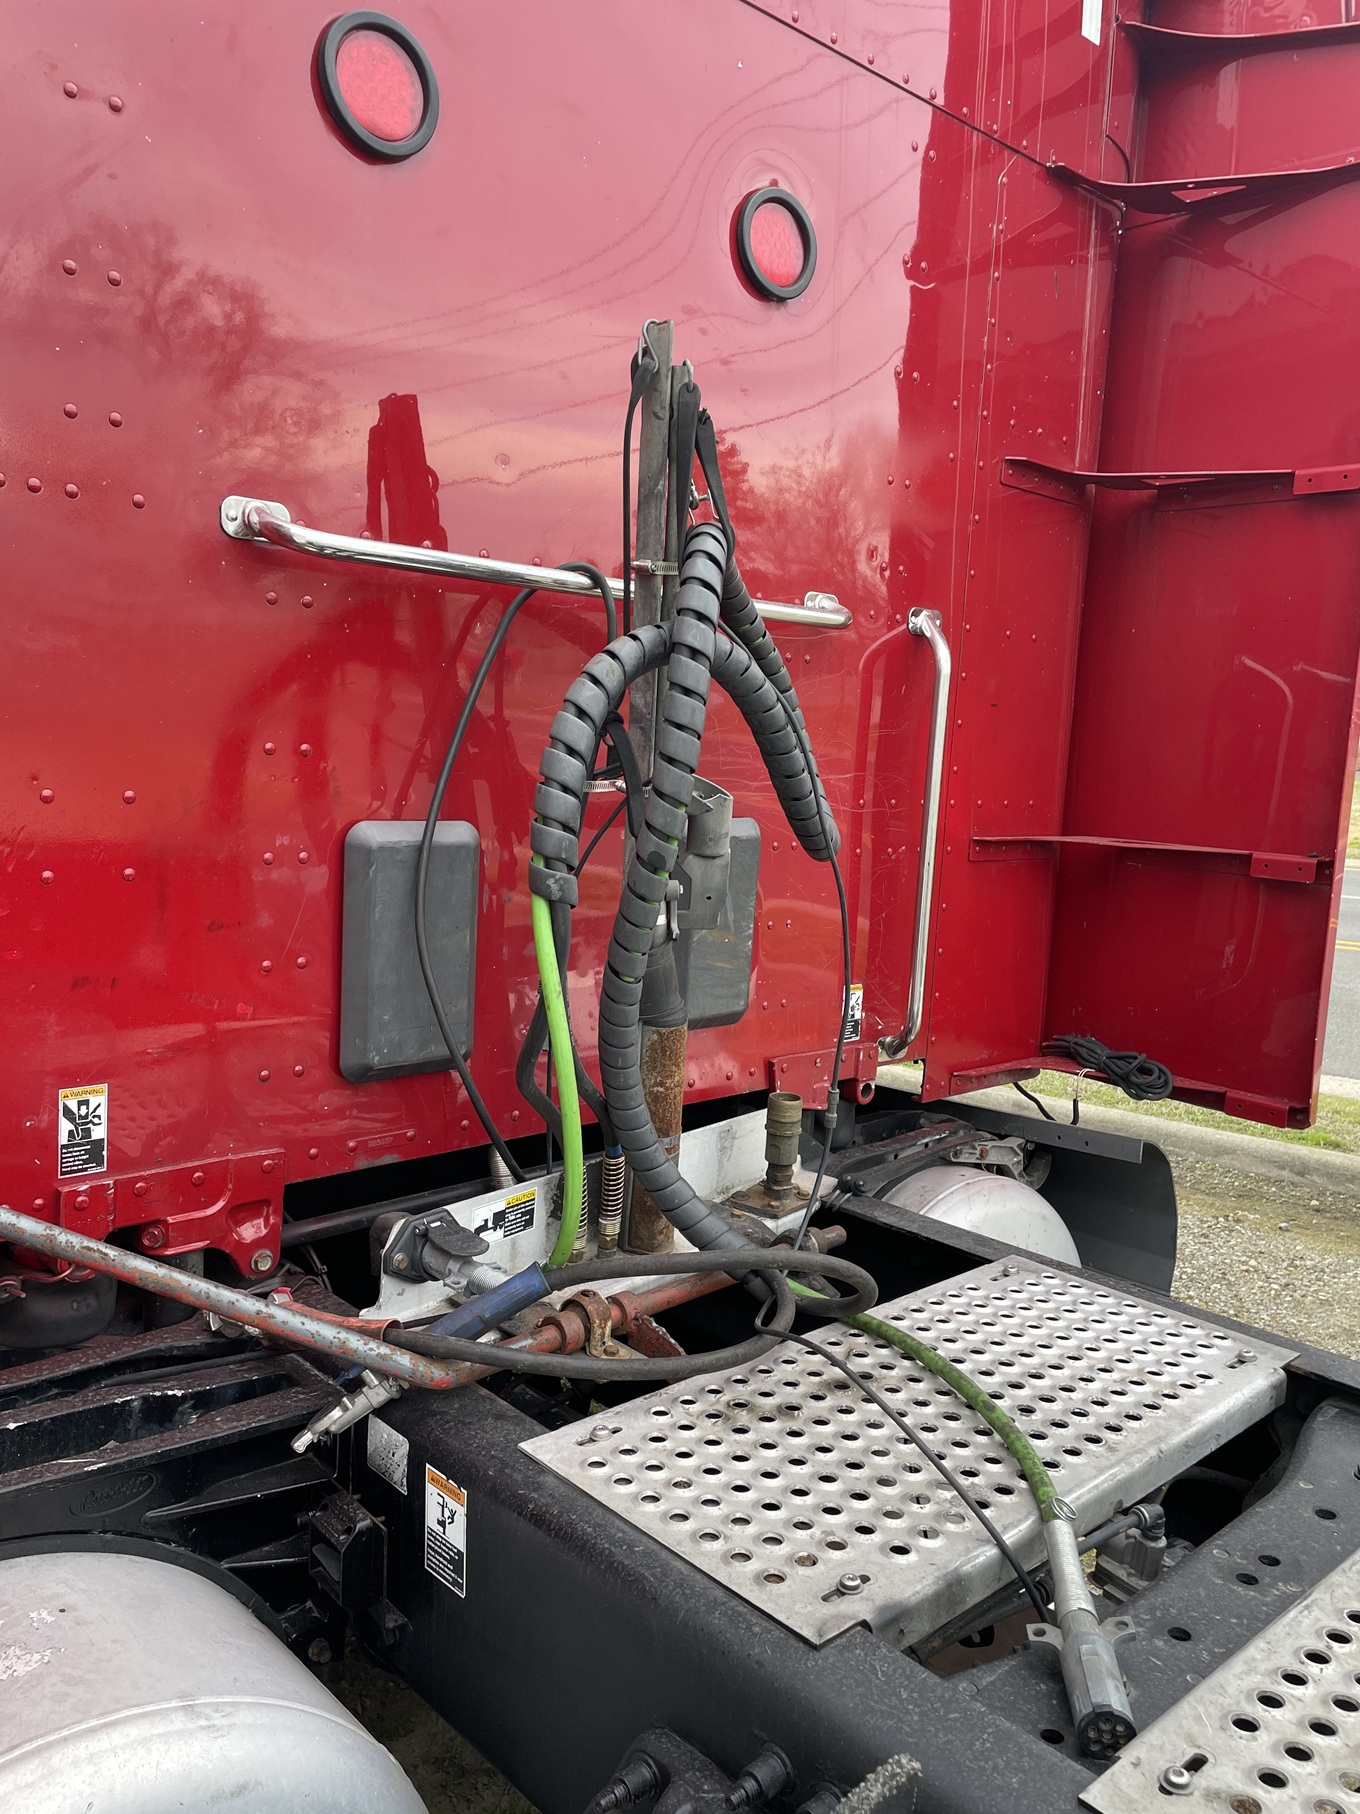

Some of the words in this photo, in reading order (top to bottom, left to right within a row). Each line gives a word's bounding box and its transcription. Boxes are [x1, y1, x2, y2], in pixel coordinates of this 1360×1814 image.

[70, 1088, 104, 1097] WARNING
[511, 1192, 535, 1204] CAUTION
[435, 1478, 462, 1501] WARNING
